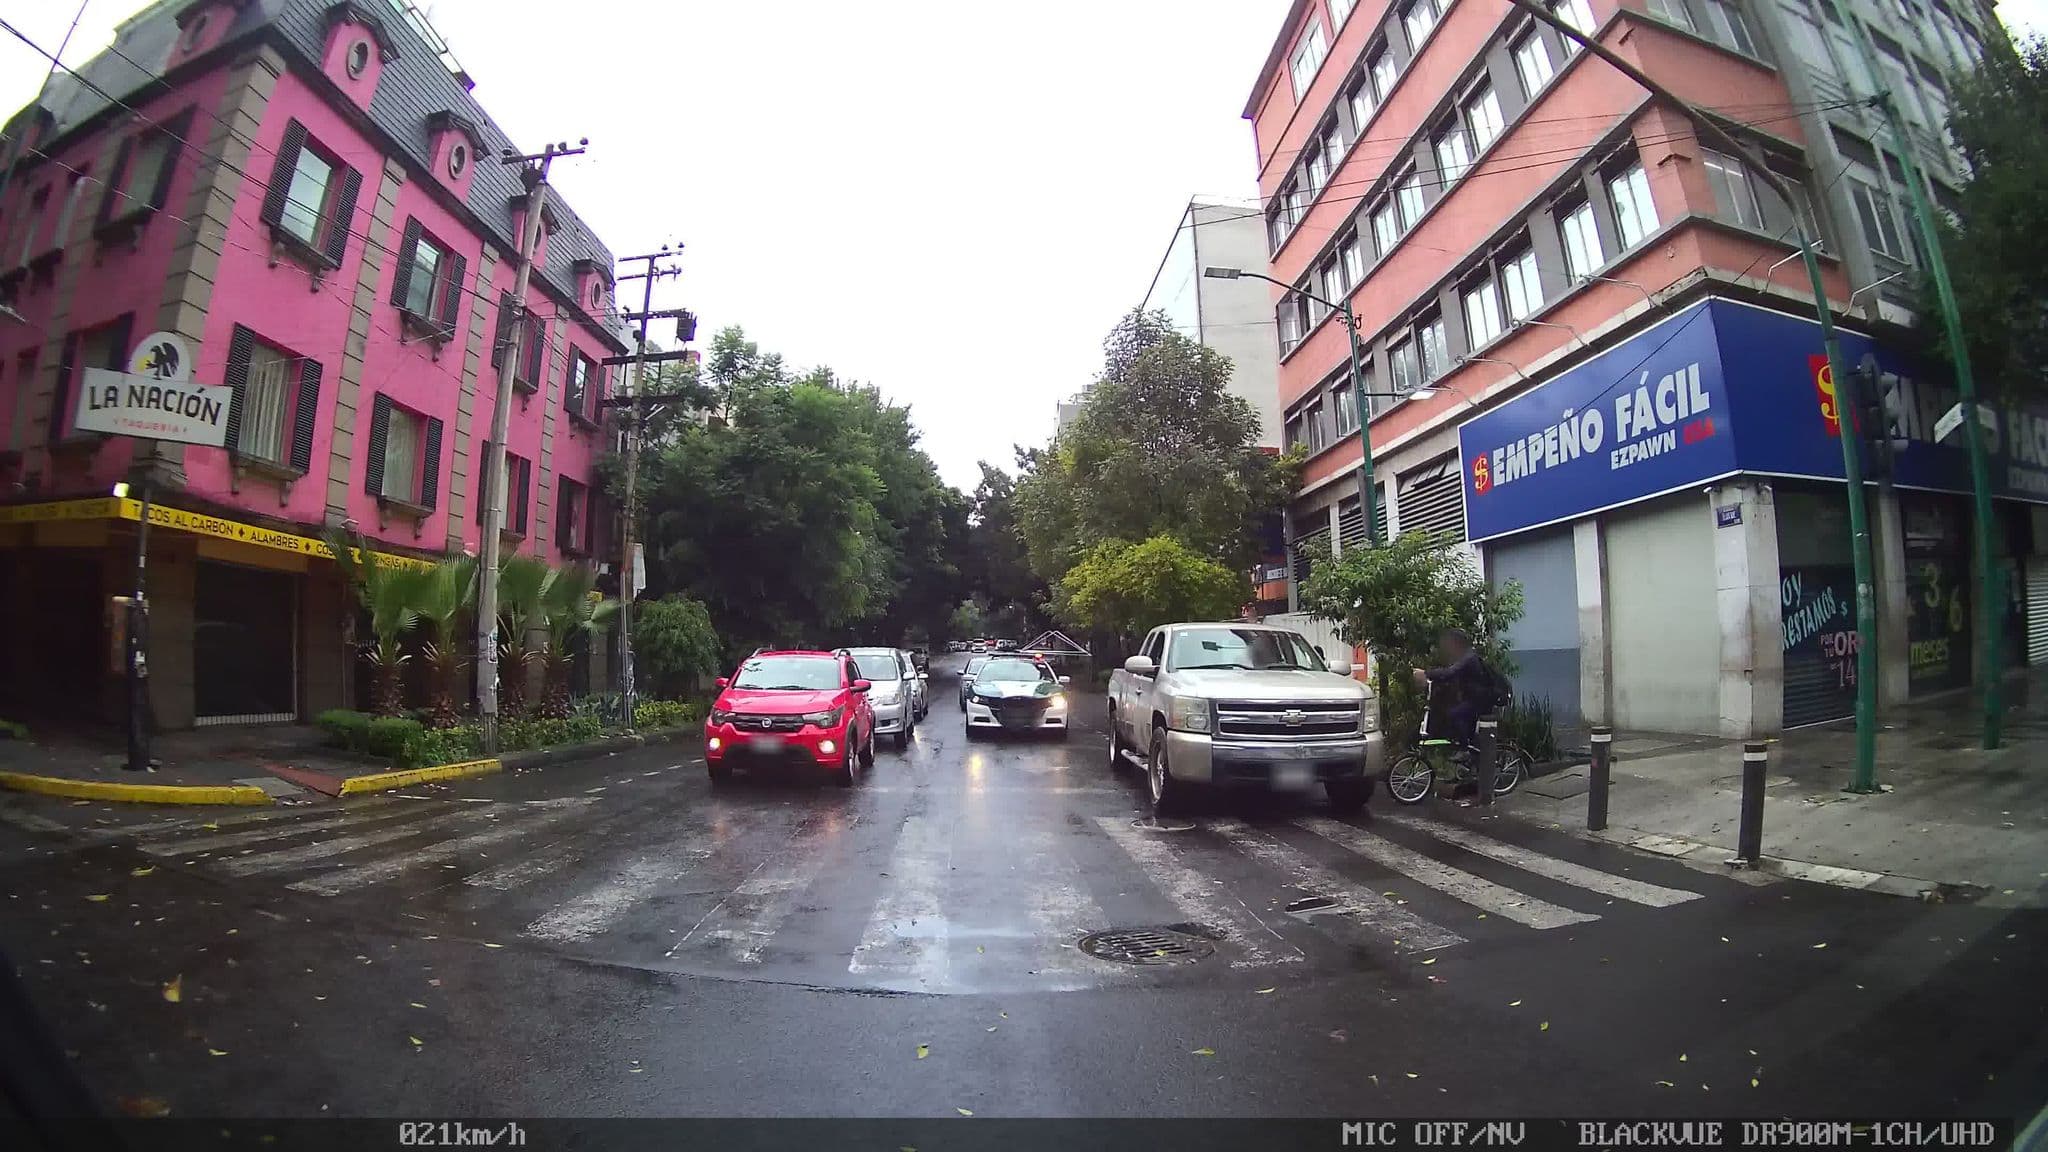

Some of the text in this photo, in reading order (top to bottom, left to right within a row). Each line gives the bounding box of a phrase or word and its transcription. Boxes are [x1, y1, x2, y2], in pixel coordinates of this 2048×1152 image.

[89, 385, 222, 426] LA NACIÓN
[1492, 408, 1604, 487] EMPEÑO
[1615, 363, 1711, 442] FÁCIL
[1611, 429, 1676, 470] EZPAWN
[132, 503, 170, 523] TCOS
[175, 514, 188, 527] AL
[250, 531, 299, 549] ALAMBRES
[1782, 571, 1801, 607] OY
[1781, 585, 1837, 651] RESTAMOS
[1834, 630, 1857, 656] OR
